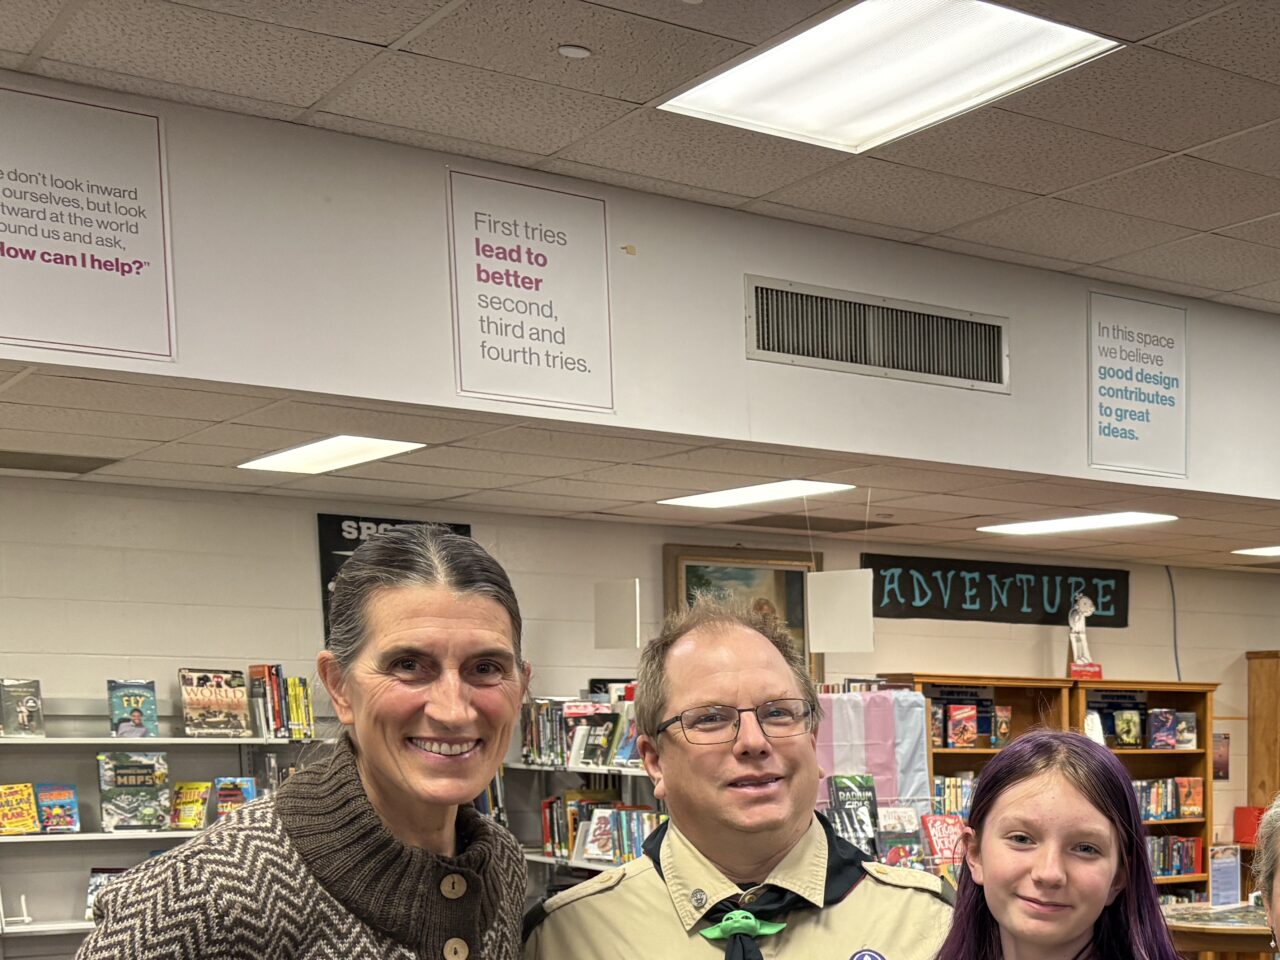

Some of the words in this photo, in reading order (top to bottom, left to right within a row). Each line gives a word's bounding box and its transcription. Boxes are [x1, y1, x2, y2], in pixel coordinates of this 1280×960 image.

[7, 169, 47, 186] don't
[50, 174, 84, 192] look
[87, 180, 138, 200] inward
[2, 187, 84, 211] ourselves,
[86, 197, 112, 214] but
[114, 202, 148, 219] look
[50, 210, 65, 224] at
[68, 212, 93, 228] the
[96, 219, 139, 234] world
[474, 211, 520, 238] First
[525, 221, 567, 246] tries
[42, 229, 60, 240] us
[63, 232, 92, 245] and
[96, 235, 126, 251] ask,
[475, 237, 522, 264] lead
[525, 247, 548, 268] to
[40, 251, 77, 267] can
[81, 253, 86, 268] I
[476, 263, 543, 291] better
[477, 293, 558, 322] second,
[479, 315, 524, 339] third
[529, 326, 566, 345] and
[1098, 322, 1110, 338] In
[1112, 324, 1135, 343] this
[1136, 332, 1175, 349] space
[480, 340, 541, 367] fourth
[545, 349, 591, 373] tries.
[1098, 345, 1118, 360] we
[1120, 345, 1164, 367] believe
[1098, 366, 1133, 380] good
[1135, 368, 1179, 390] design
[1098, 385, 1176, 407] contributes
[1098, 402, 1113, 418] to
[1115, 407, 1151, 423] great
[1098, 421, 1139, 441] ideas.
[880, 568, 1116, 616] ADVENTURE
[122, 695, 145, 709] FLY
[185, 687, 245, 700] WORLD
